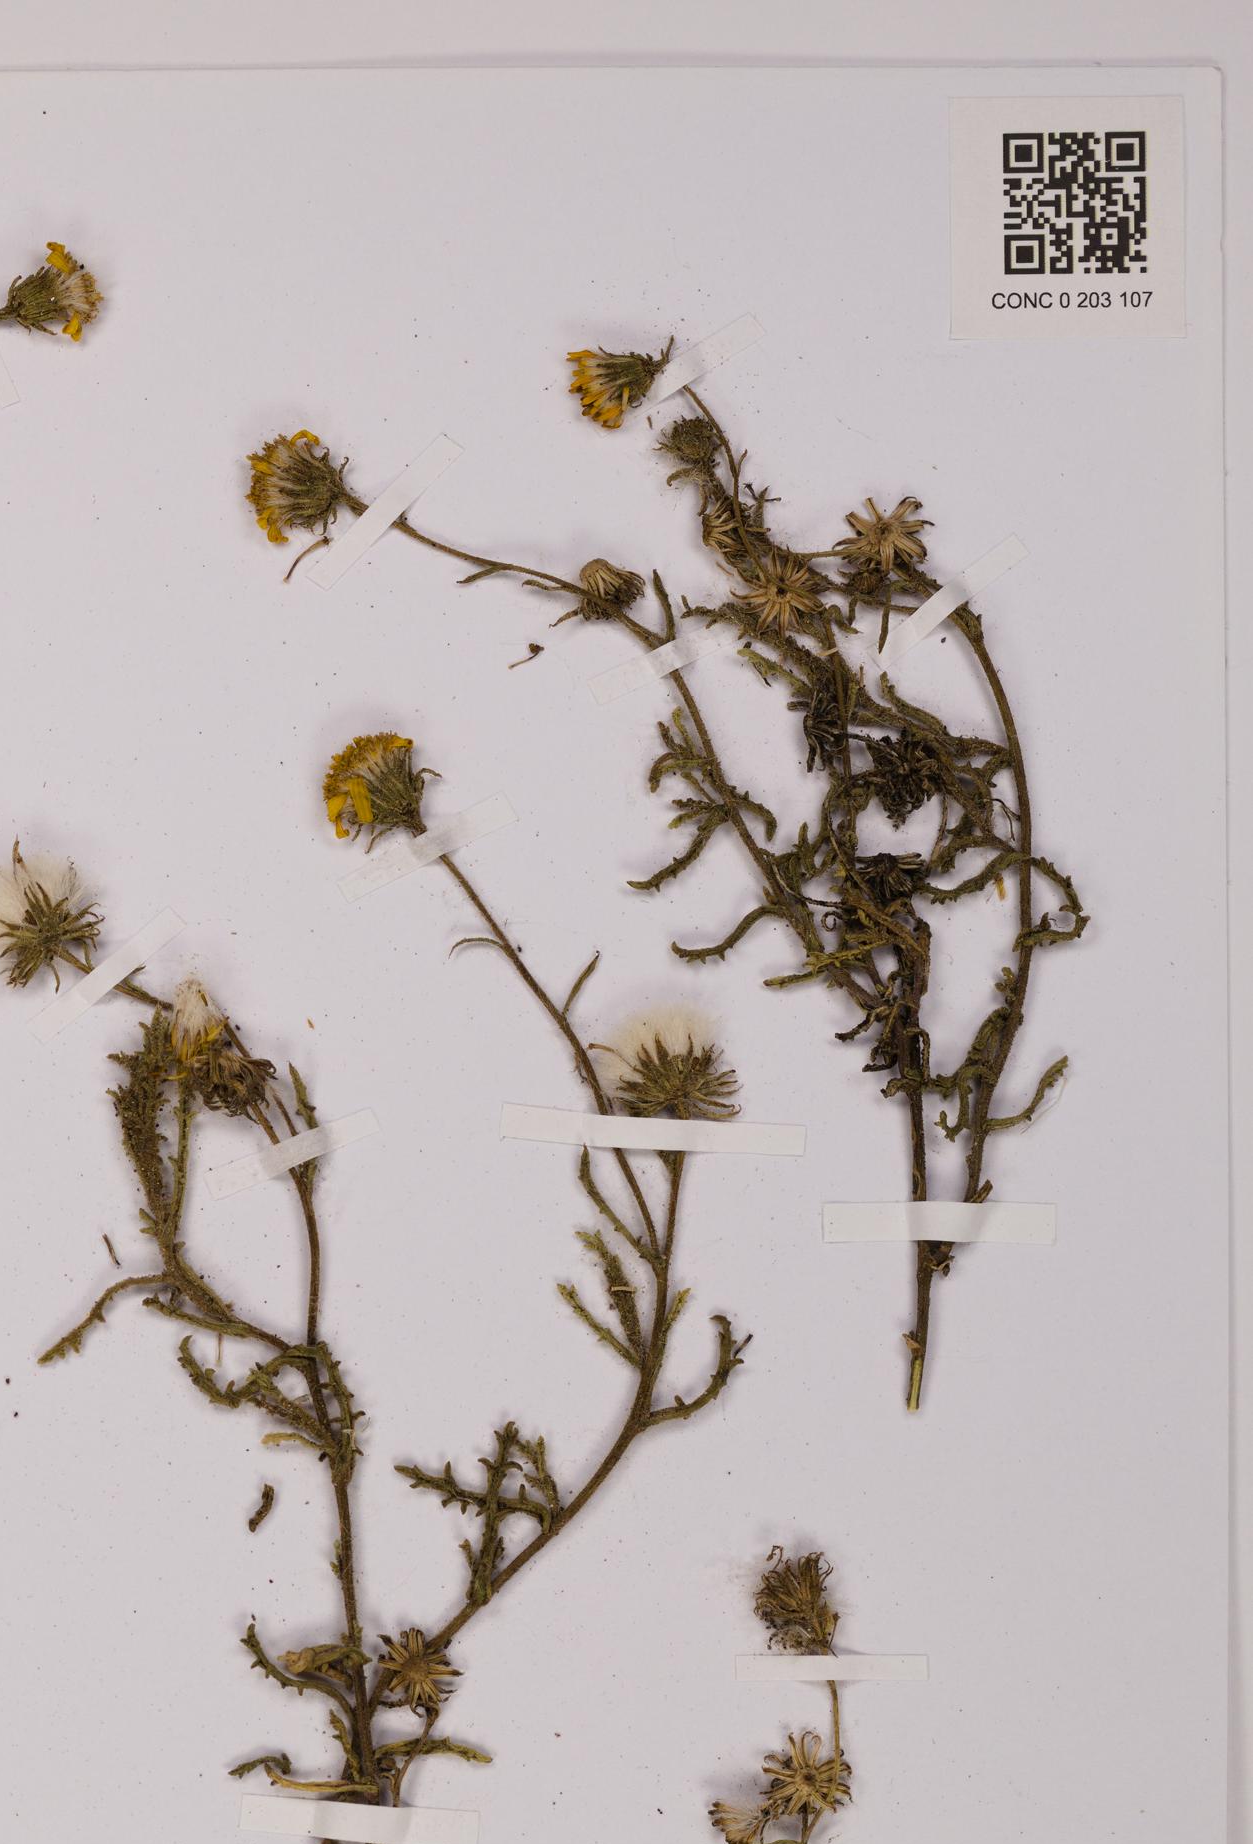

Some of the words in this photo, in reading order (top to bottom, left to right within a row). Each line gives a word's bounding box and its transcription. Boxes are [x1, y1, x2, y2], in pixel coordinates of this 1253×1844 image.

[991, 291, 1053, 310] CONC
[1059, 292, 1071, 309] 0
[1077, 291, 1112, 309] 203
[1119, 291, 1153, 308] 107
